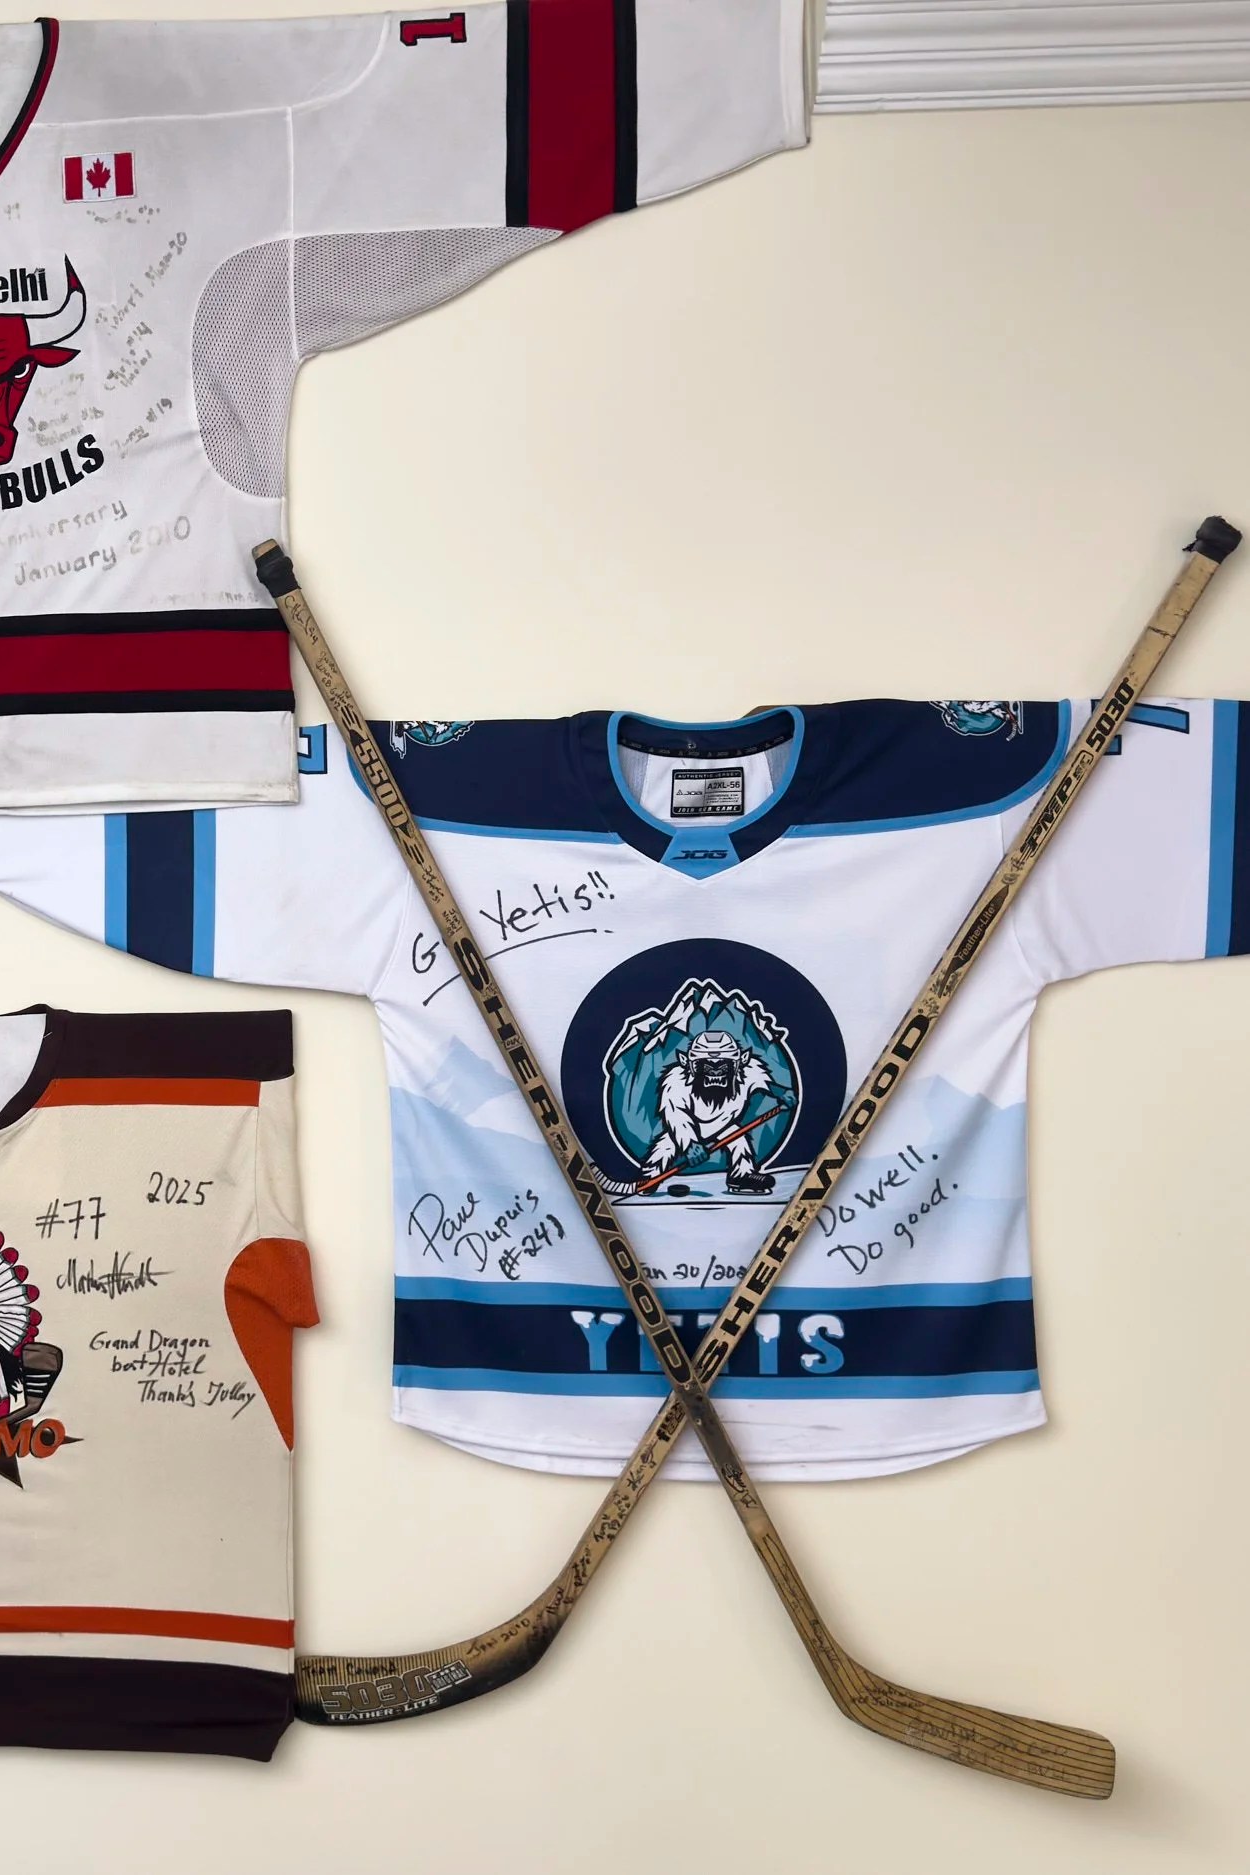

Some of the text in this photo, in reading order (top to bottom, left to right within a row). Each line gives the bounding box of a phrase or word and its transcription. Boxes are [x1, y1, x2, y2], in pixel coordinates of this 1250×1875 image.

[0, 434, 104, 511] BULLS
[14, 546, 117, 587] January
[1086, 682, 1135, 752] 5030
[355, 738, 410, 829] 5500
[453, 937, 693, 1384] SHER-WOOD
[36, 1197, 106, 1240] #77
[697, 1011, 927, 1384] SHER-WOOD
[454, 1189, 539, 1272] Dupuis
[827, 1242, 883, 1275] Do
[638, 1262, 668, 1281] an
[90, 1330, 211, 1357] Grand Dragon
[148, 1351, 207, 1377] Hotel
[570, 1310, 845, 1376] YIS
[317, 1666, 436, 1715] 5030
